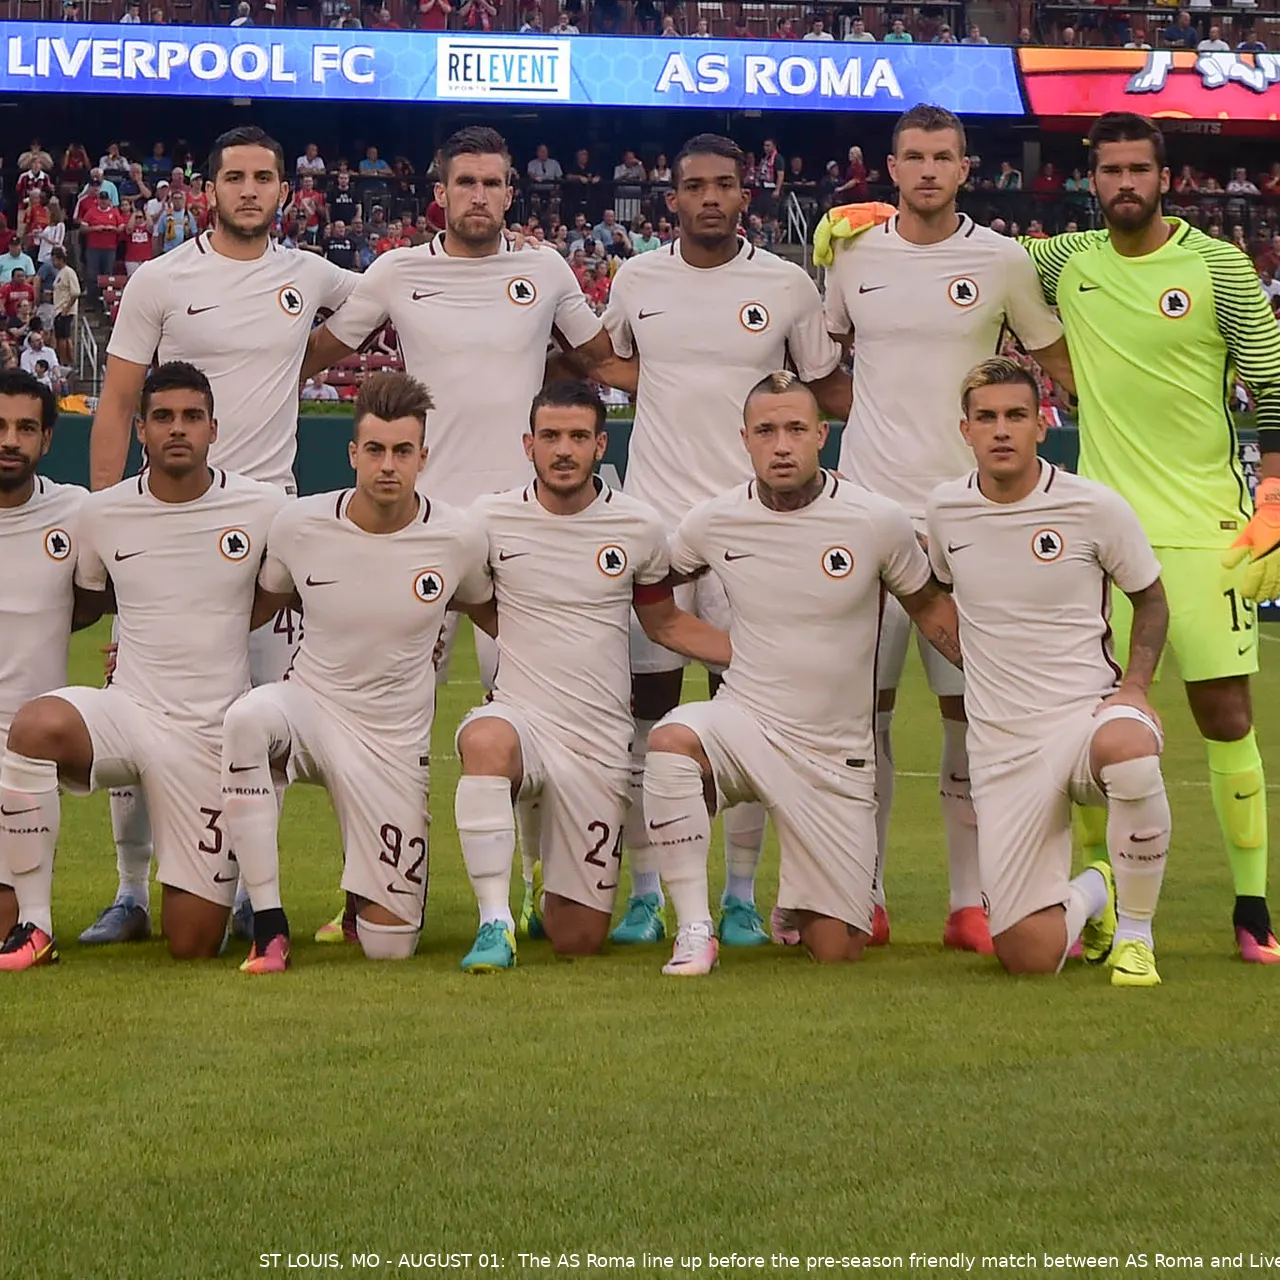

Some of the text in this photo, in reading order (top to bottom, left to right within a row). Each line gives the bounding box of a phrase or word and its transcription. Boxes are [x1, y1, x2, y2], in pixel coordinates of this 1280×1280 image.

[7, 36, 377, 85] LIVERPOOL FC
[448, 52, 559, 85] RELEVENT
[655, 51, 904, 100] AS ROMA
[379, 823, 426, 885] 92
